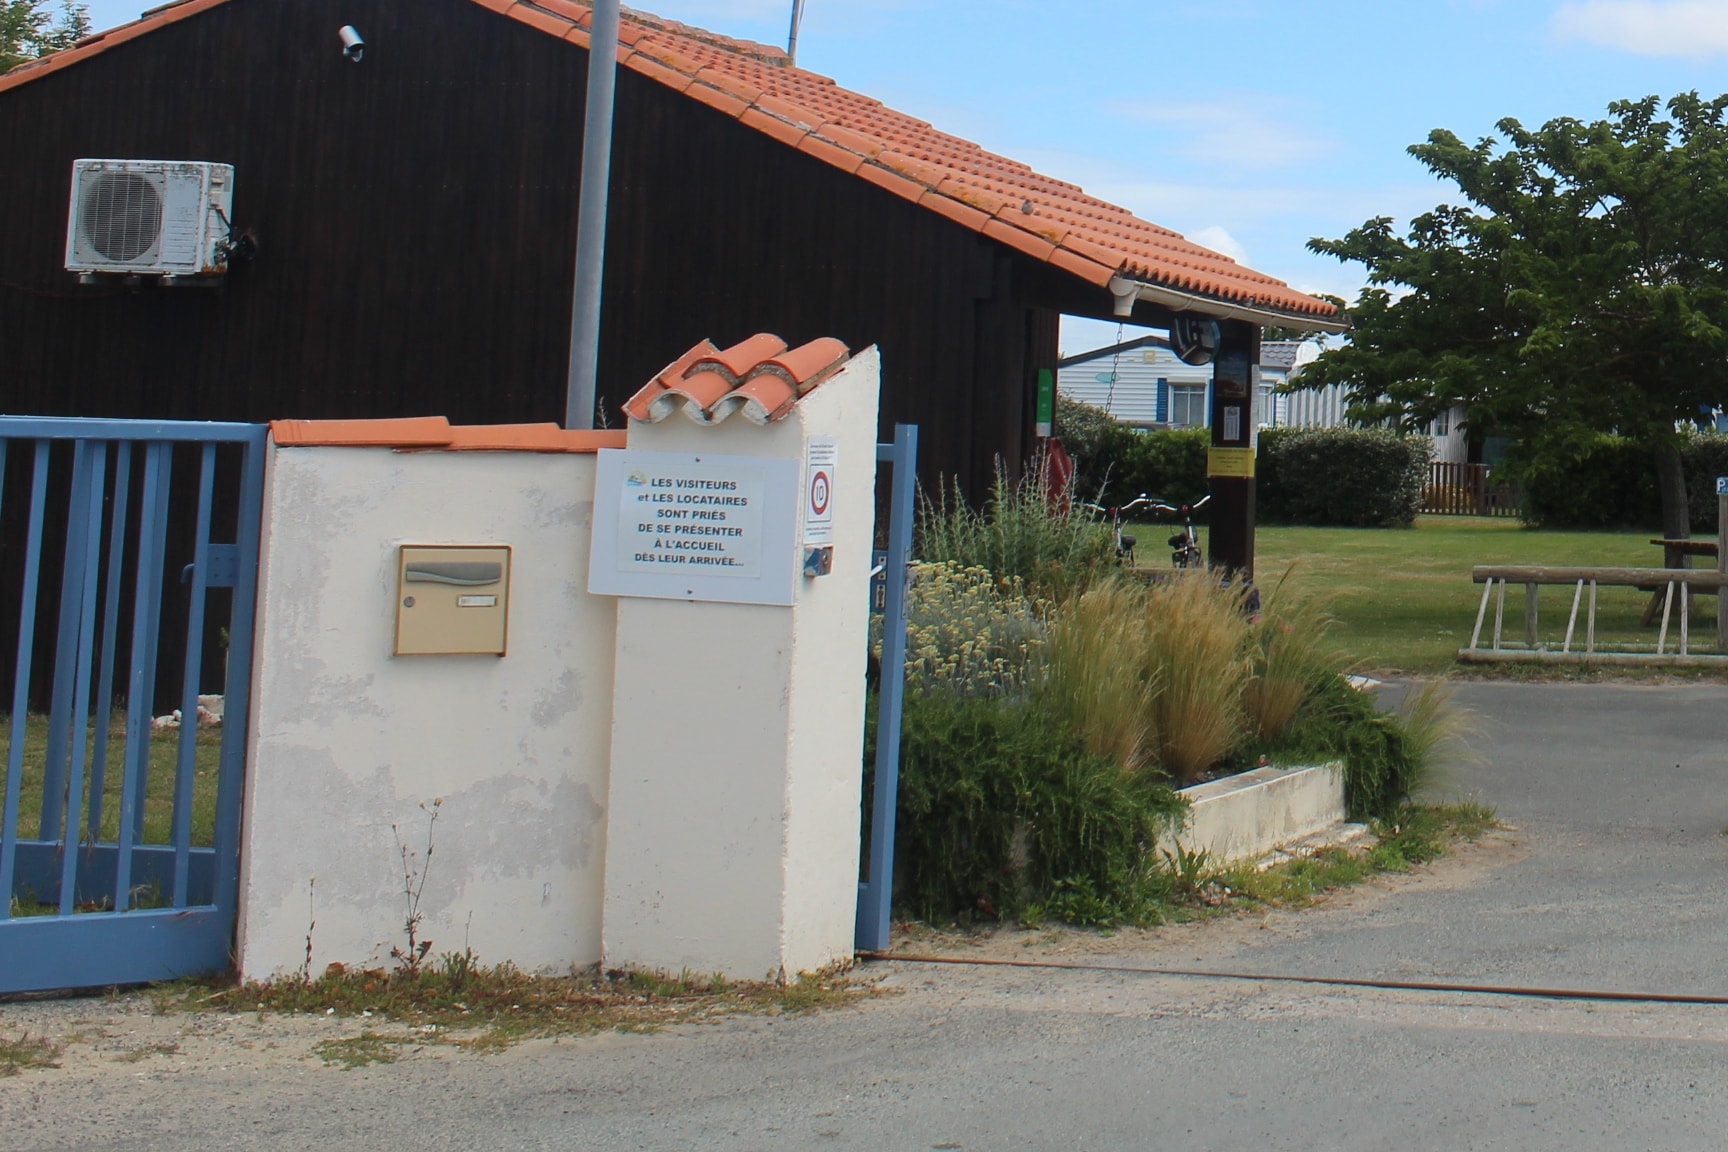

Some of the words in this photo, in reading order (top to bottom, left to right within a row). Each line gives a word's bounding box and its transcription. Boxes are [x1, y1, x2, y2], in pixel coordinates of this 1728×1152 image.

[652, 479, 672, 487] LES
[676, 480, 736, 490] VISITEURS
[1718, 480, 1725, 491] P
[816, 486, 823, 501] 10
[653, 494, 673, 502] LES
[677, 495, 747, 506] LOCATAIRES
[658, 509, 688, 518] SONT
[692, 511, 726, 520] PRIÉS
[638, 524, 653, 532] DE
[657, 525, 671, 533] SE
[675, 524, 743, 536] PRÉSENTER
[655, 538, 662, 548] À
[666, 540, 725, 551] L'ACCUEIL
[658, 555, 686, 563] LEUR
